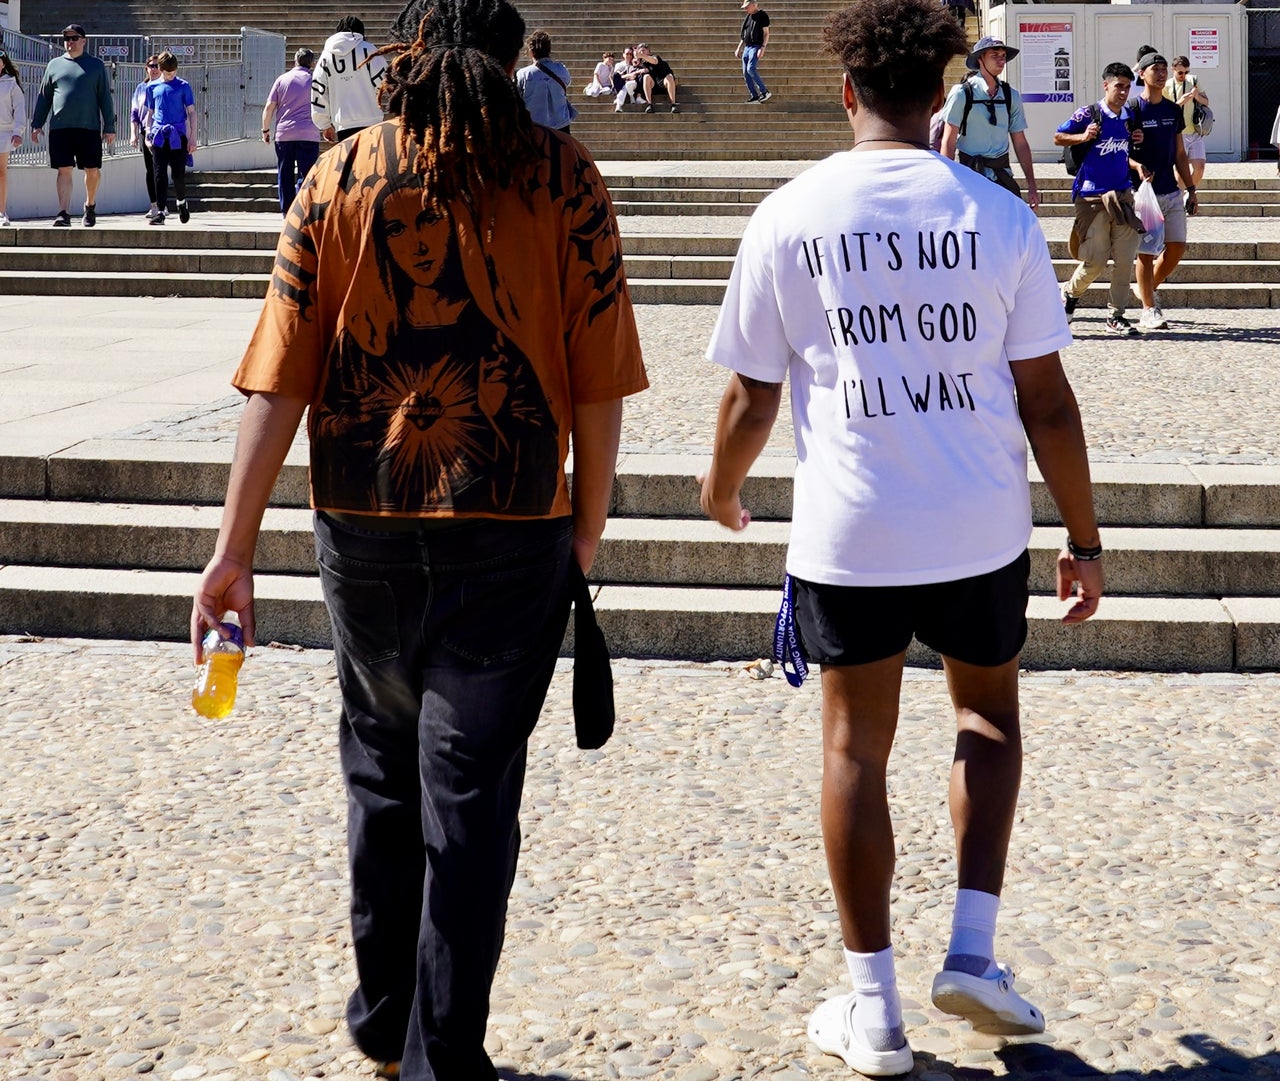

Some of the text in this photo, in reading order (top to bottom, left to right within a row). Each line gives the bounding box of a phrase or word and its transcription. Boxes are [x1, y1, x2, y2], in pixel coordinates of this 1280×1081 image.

[1026, 24, 1049, 32] 1776
[1045, 94, 1072, 102] 2026
[802, 231, 981, 278] IF IT'S NOT
[825, 302, 977, 347] FROM GOD
[844, 372, 976, 419] I'LL WAIT
[776, 600, 789, 658] OPPORTUNITY
[792, 651, 807, 680] REATING
